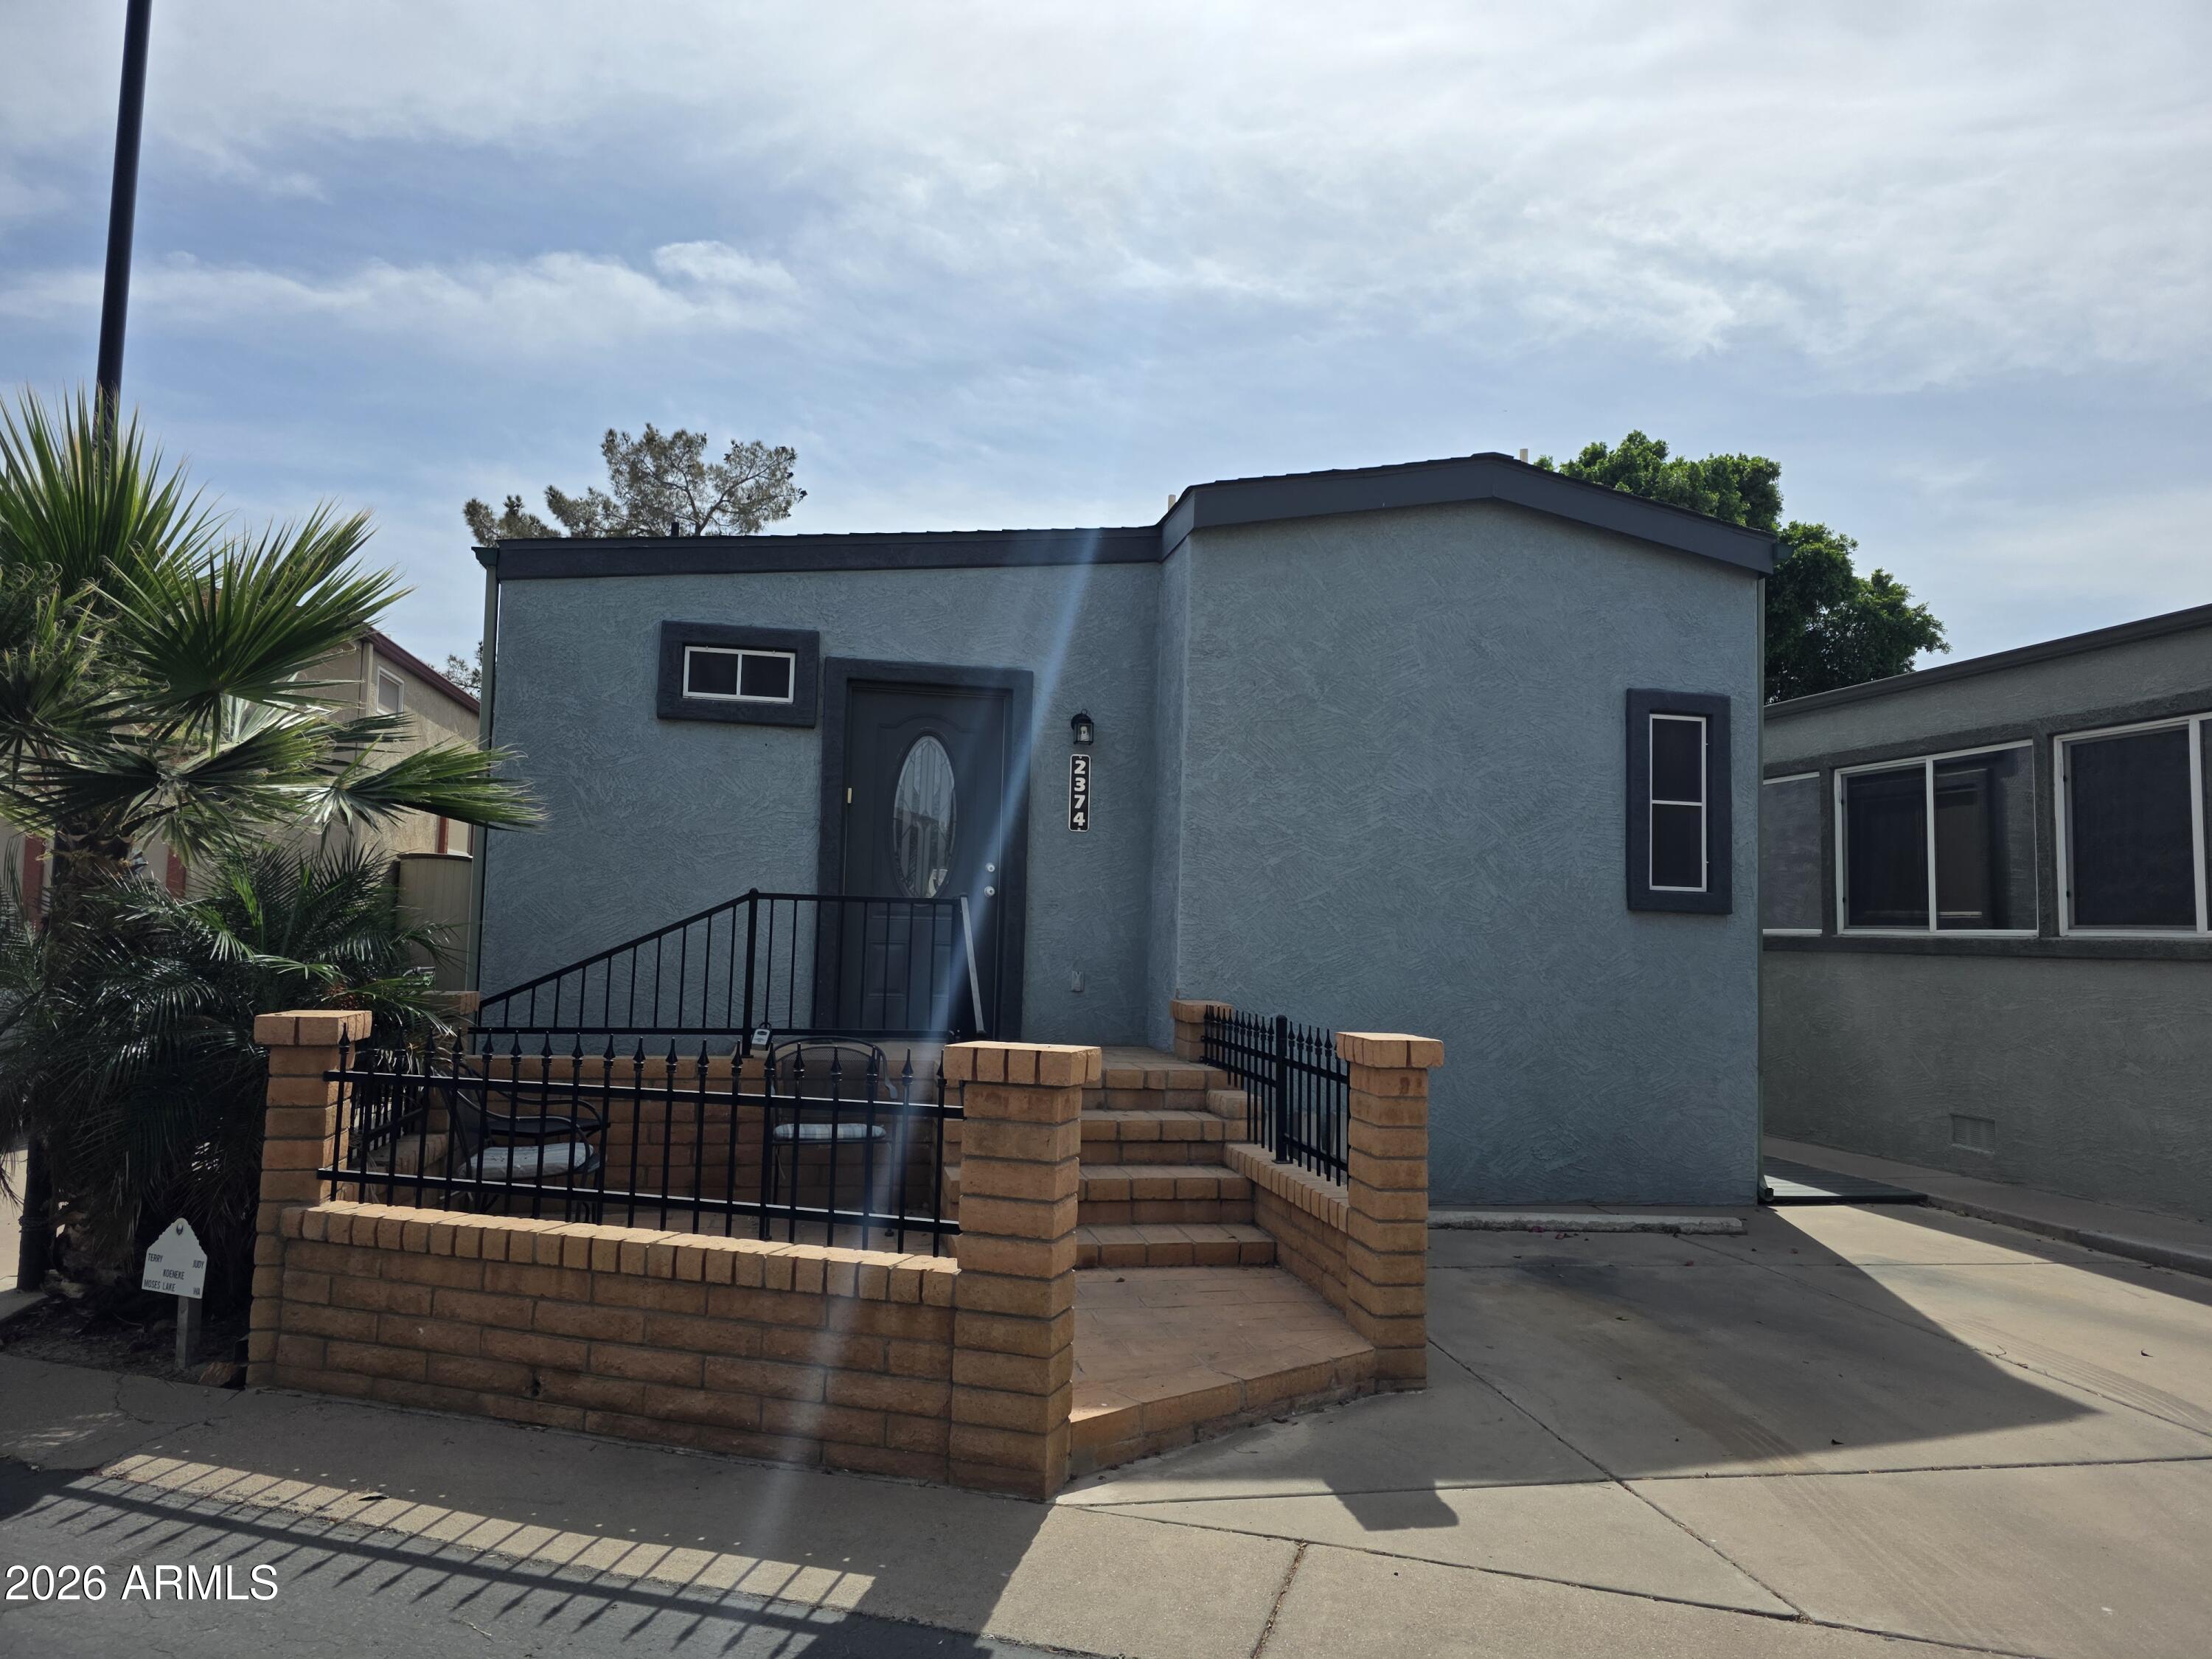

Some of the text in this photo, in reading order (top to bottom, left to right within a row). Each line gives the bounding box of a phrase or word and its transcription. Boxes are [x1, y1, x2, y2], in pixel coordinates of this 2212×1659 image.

[1073, 760, 1086, 827] 2374
[147, 1253, 204, 1269] TERRY JUDY
[163, 1268, 185, 1280] KOENEKE
[144, 1279, 201, 1295] MOSES LAKE WA
